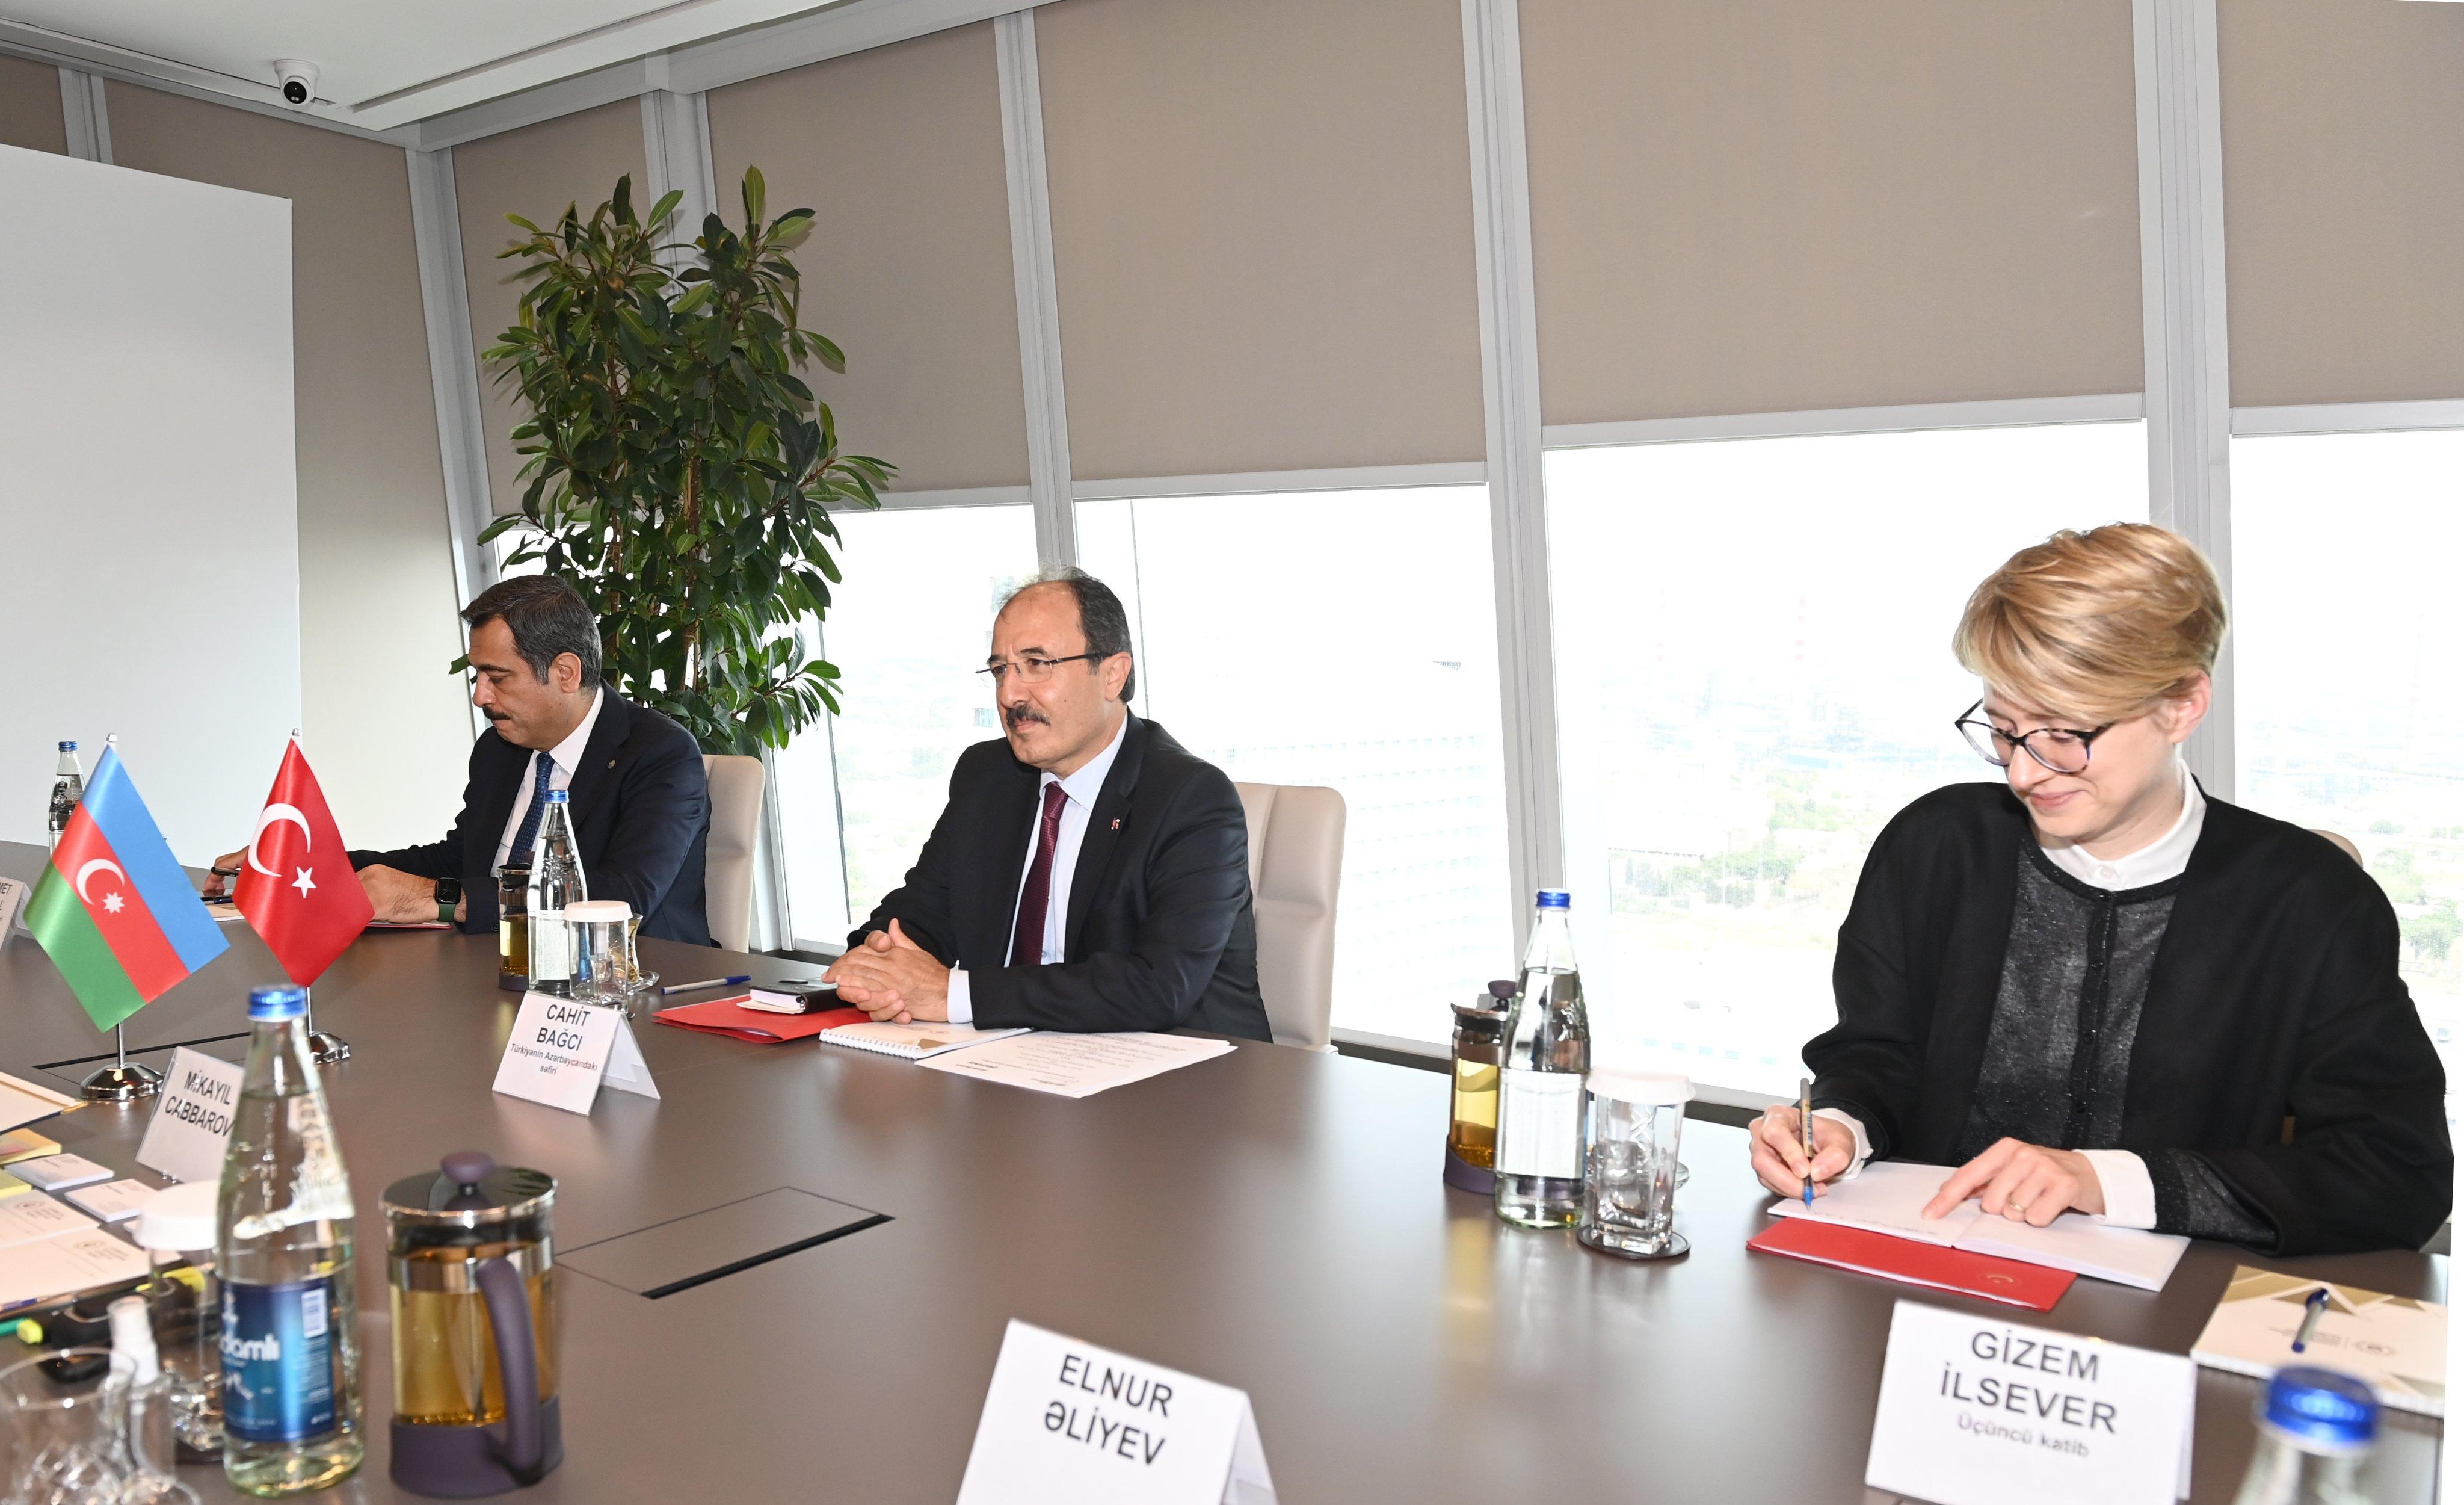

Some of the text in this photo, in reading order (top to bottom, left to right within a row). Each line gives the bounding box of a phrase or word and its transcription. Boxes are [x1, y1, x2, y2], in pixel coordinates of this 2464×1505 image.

[547, 1004, 590, 1026] CAHİT
[511, 1043, 544, 1058] Türkiyənin
[537, 1027, 583, 1051] BAĞCI
[540, 1065, 558, 1075] səfiri
[164, 1096, 235, 1137] CABBAROV
[1972, 1329, 2098, 1382] GİZEM
[1060, 1355, 1172, 1416] ELNUR
[1941, 1362, 2117, 1433] İLSEVER
[1045, 1401, 1165, 1464] ƏLİYEV
[1957, 1411, 2090, 1457] Üçüncü katib
